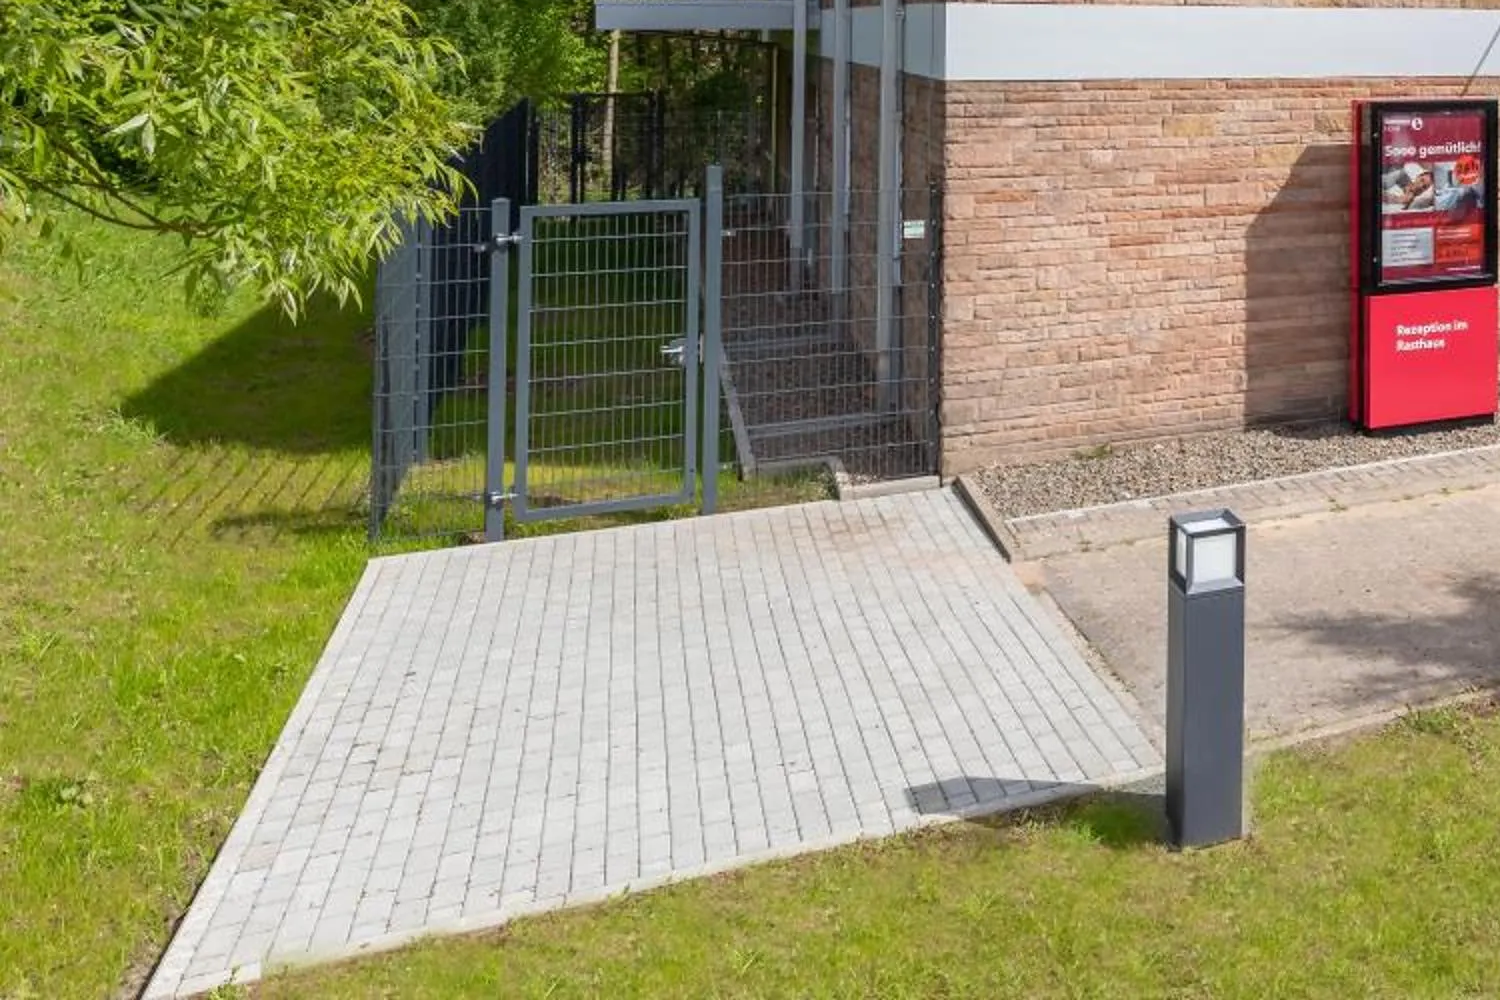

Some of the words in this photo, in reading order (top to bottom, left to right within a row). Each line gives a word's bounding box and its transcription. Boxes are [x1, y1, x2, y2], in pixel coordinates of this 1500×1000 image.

[1419, 140, 1482, 158] gemütlich!
[1396, 321, 1452, 337] Rezeption
[1454, 319, 1468, 331] im
[1396, 338, 1446, 351] Rasthaus
